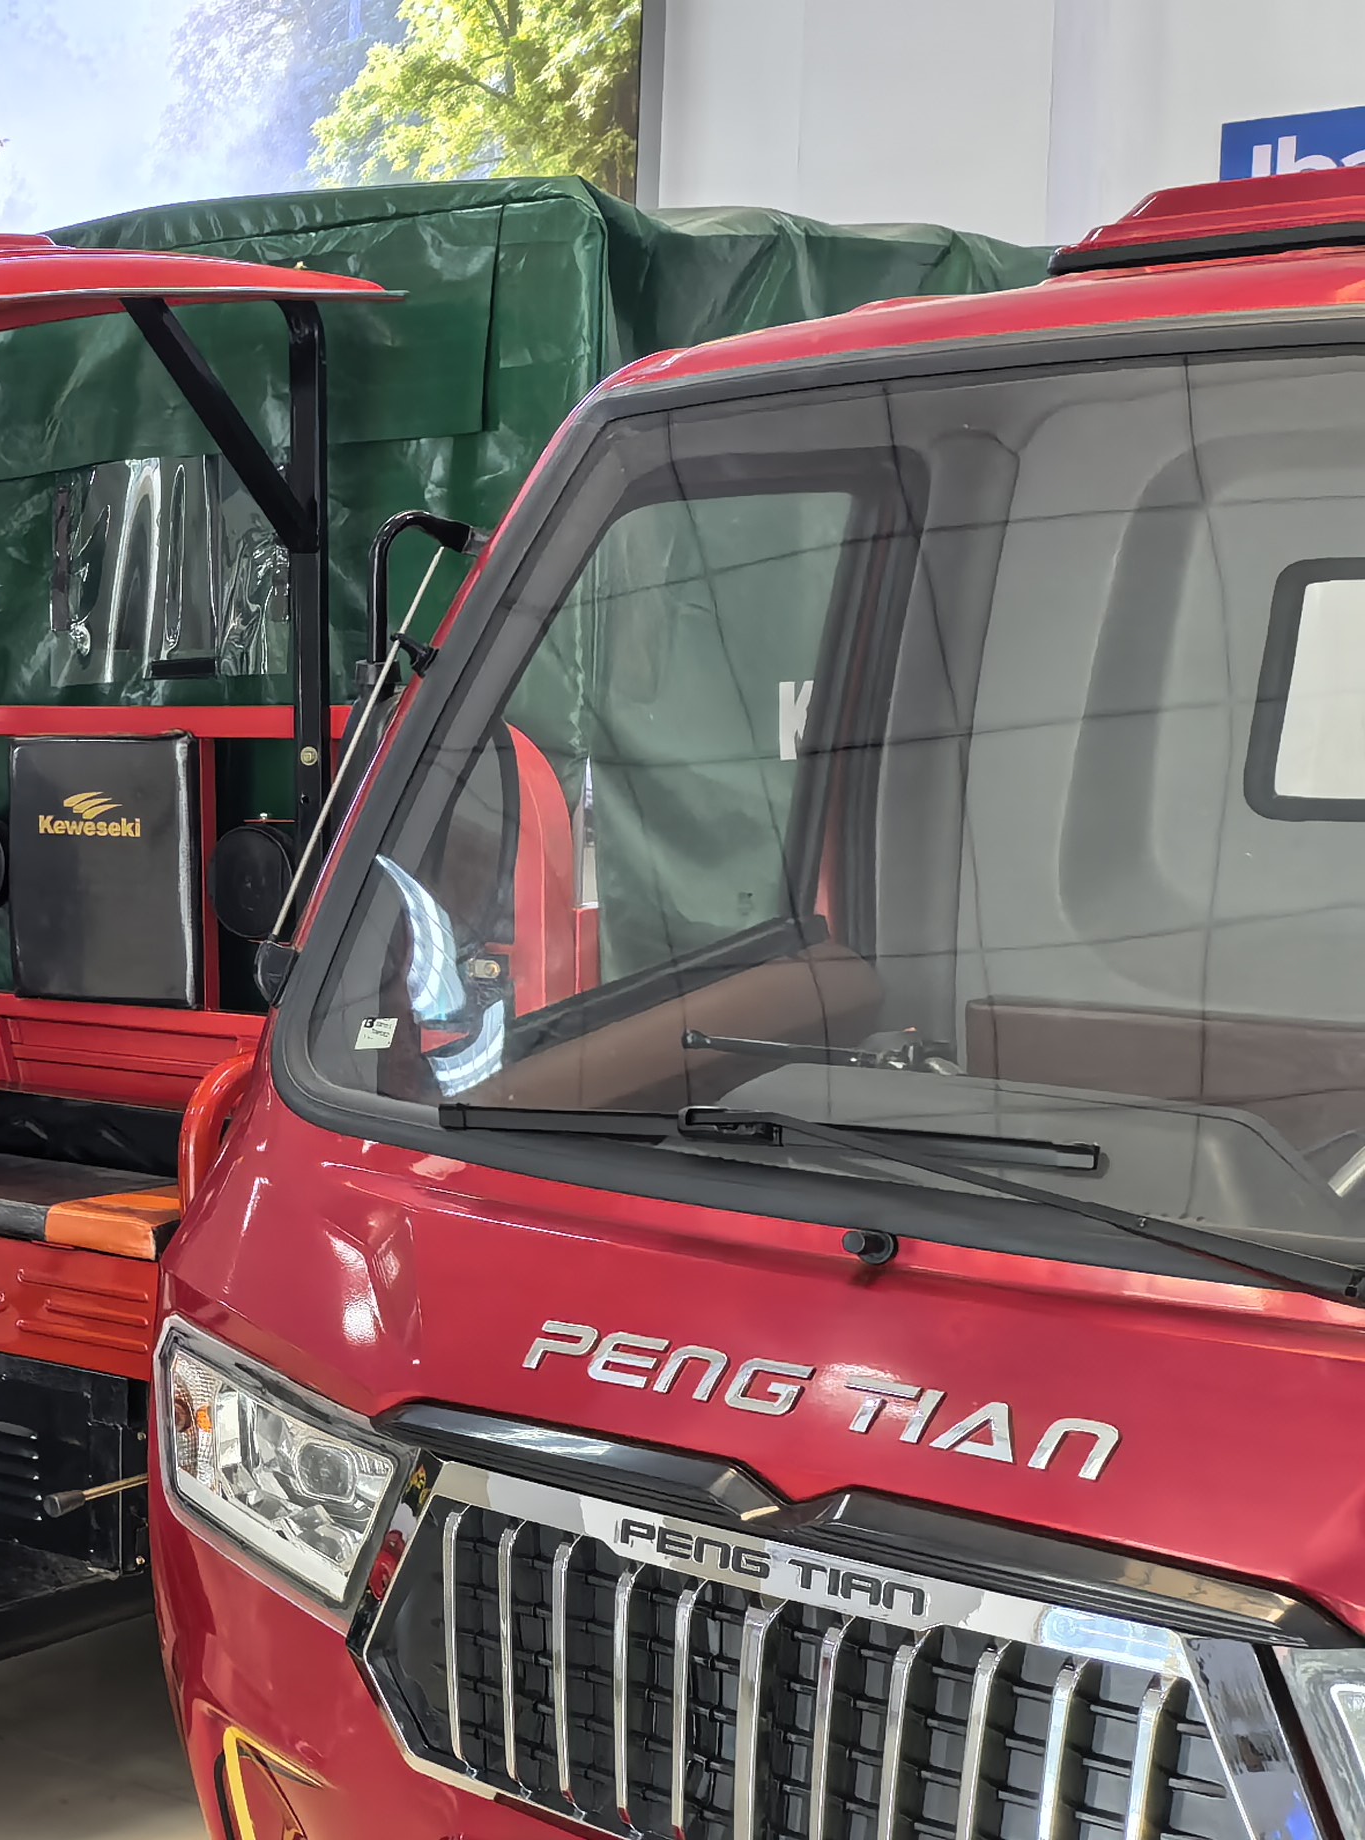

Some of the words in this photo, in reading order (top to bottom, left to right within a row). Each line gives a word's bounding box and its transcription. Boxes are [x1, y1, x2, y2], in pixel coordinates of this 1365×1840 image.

[38, 814, 141, 838] Keweseki
[521, 1319, 816, 1416] PENG
[844, 1373, 1120, 1482] TIAN
[619, 1516, 772, 1580] PENG
[787, 1556, 929, 1618] TIAN
